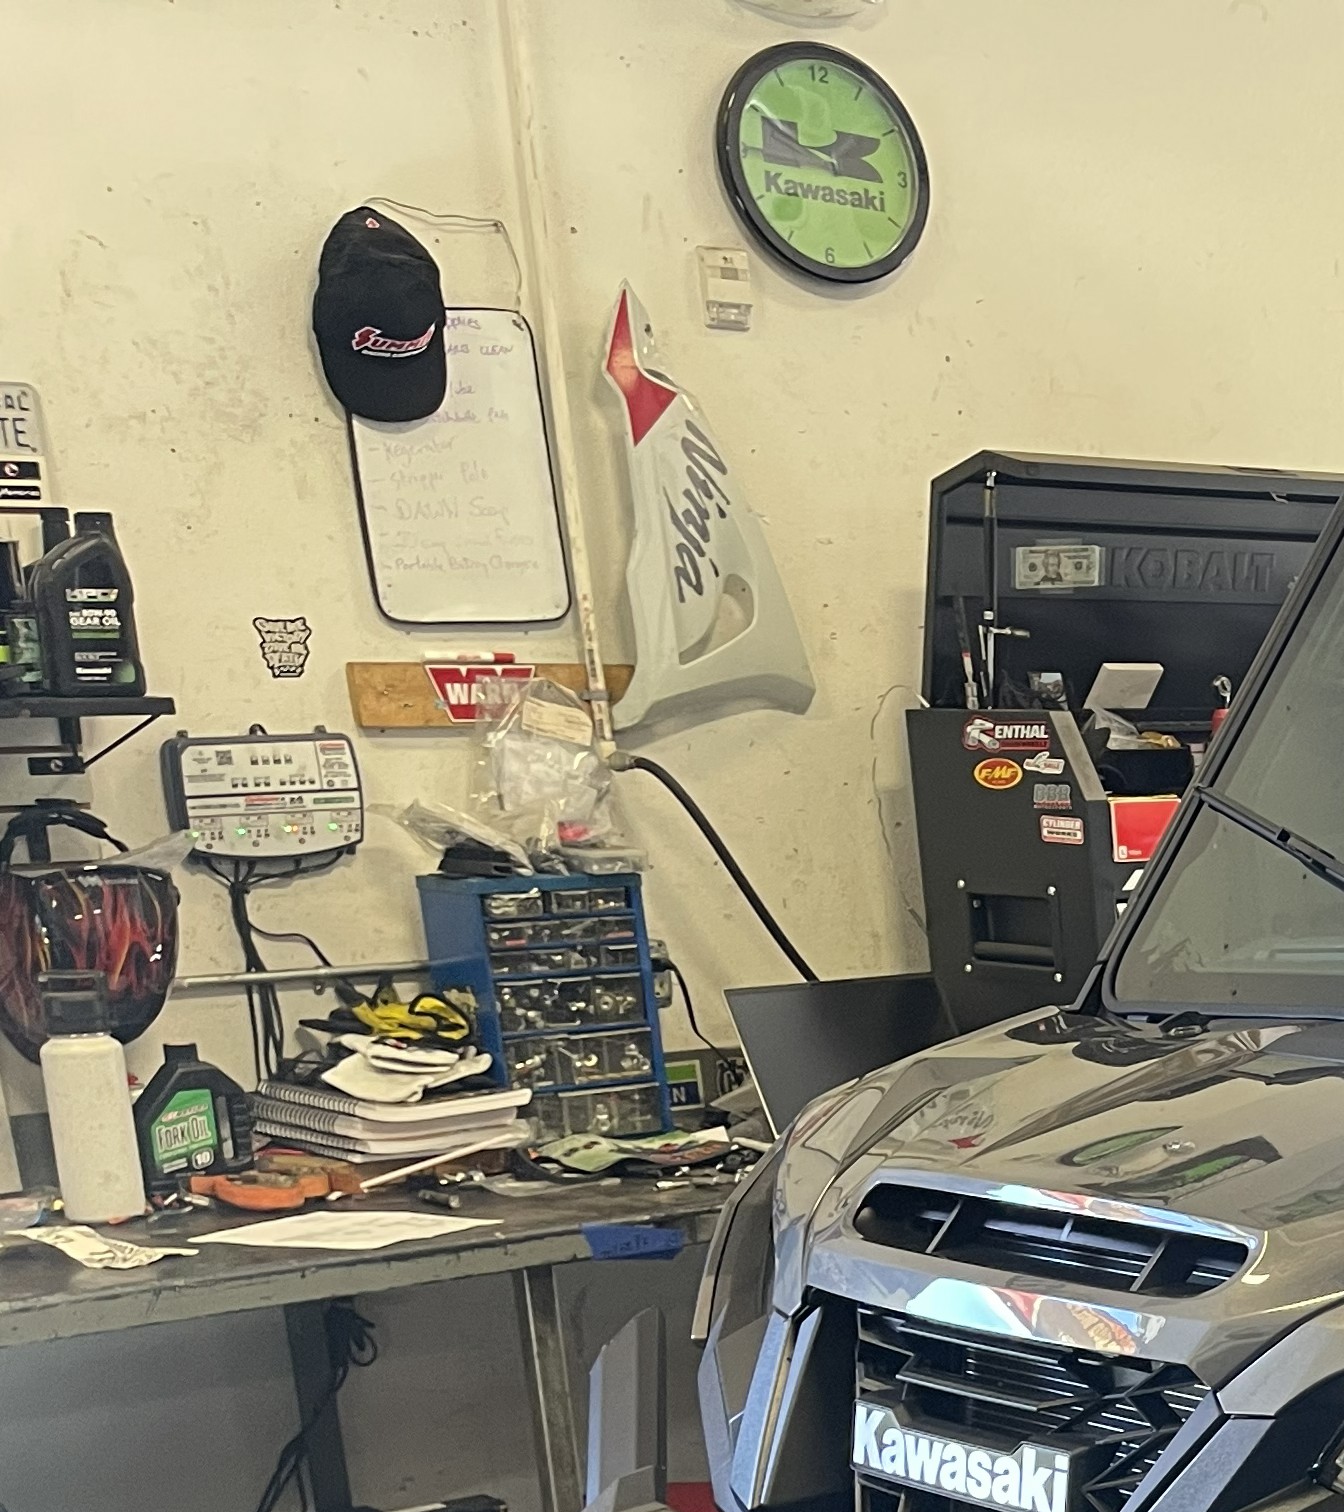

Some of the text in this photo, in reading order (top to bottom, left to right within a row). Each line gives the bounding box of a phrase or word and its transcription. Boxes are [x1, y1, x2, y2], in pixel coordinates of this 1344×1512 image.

[808, 65, 829, 84] 12
[764, 170, 886, 213] Kawasaki
[896, 171, 908, 189] 3
[824, 247, 836, 264] 6
[663, 418, 731, 603] Ninja
[1110, 546, 1276, 593] KOBALT
[979, 766, 1017, 779] FMF
[156, 1115, 212, 1153] FORK OIL
